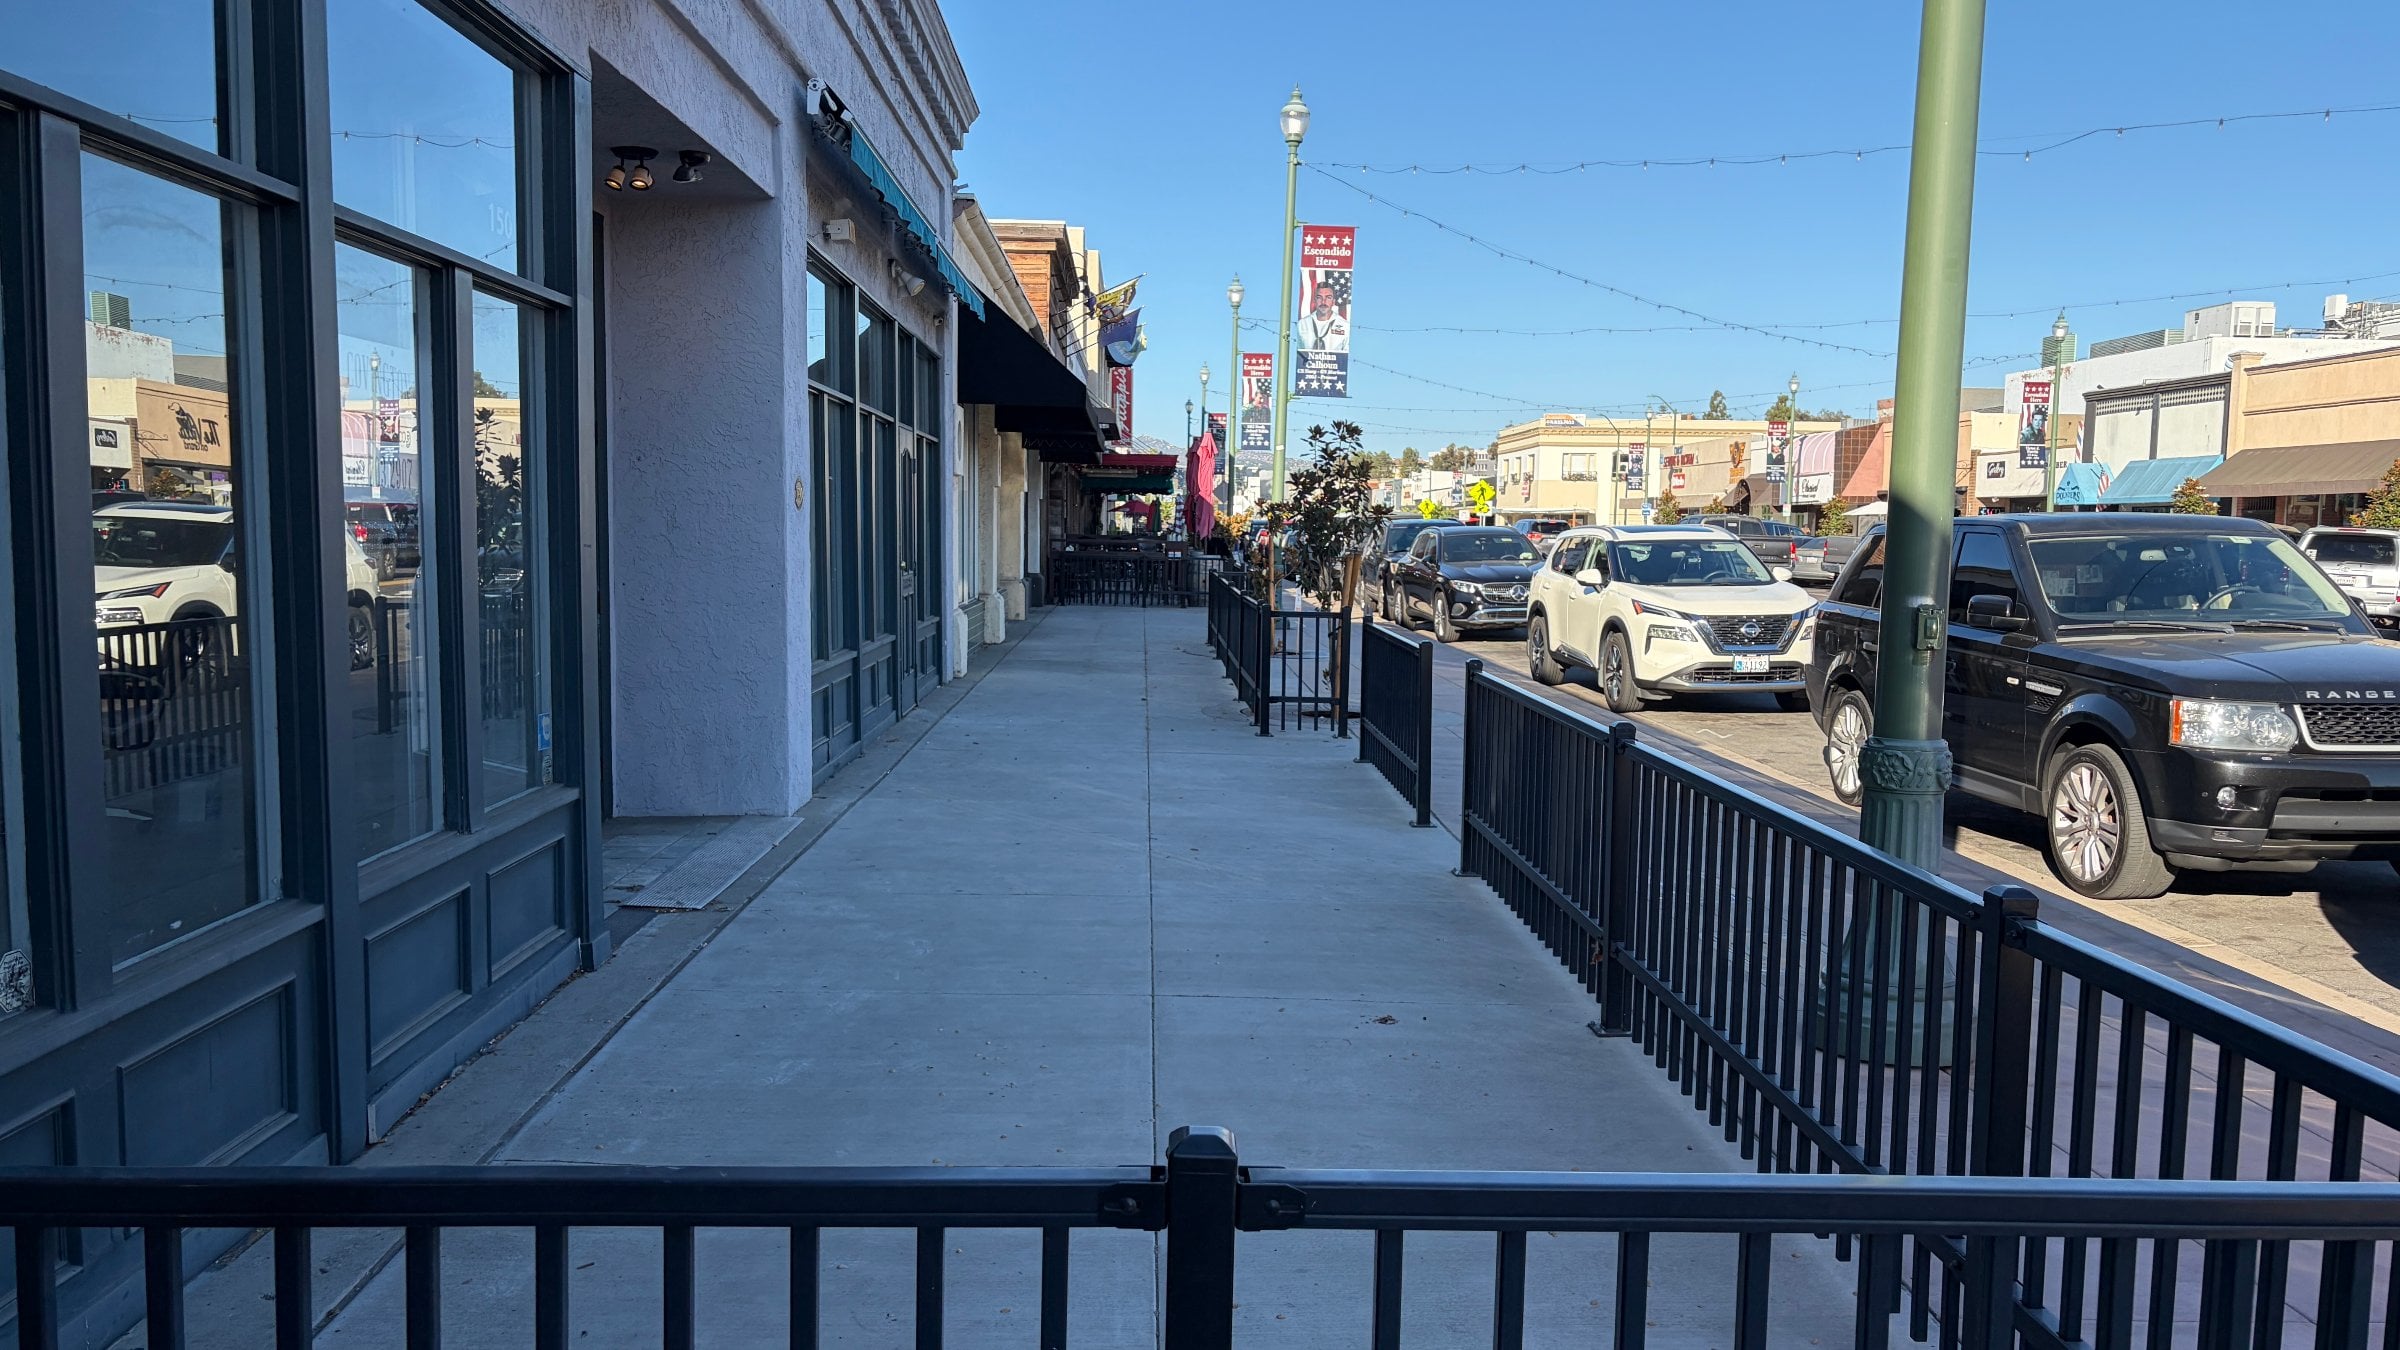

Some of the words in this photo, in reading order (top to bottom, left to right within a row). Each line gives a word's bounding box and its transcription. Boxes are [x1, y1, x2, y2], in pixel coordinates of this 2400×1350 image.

[489, 203, 513, 239] 150
[1304, 246, 1352, 256] Escondido
[1315, 257, 1339, 267] Hero
[1308, 352, 1337, 361] Nathan
[1305, 361, 1338, 370] Calhoun
[2305, 690, 2397, 699] RANGE
